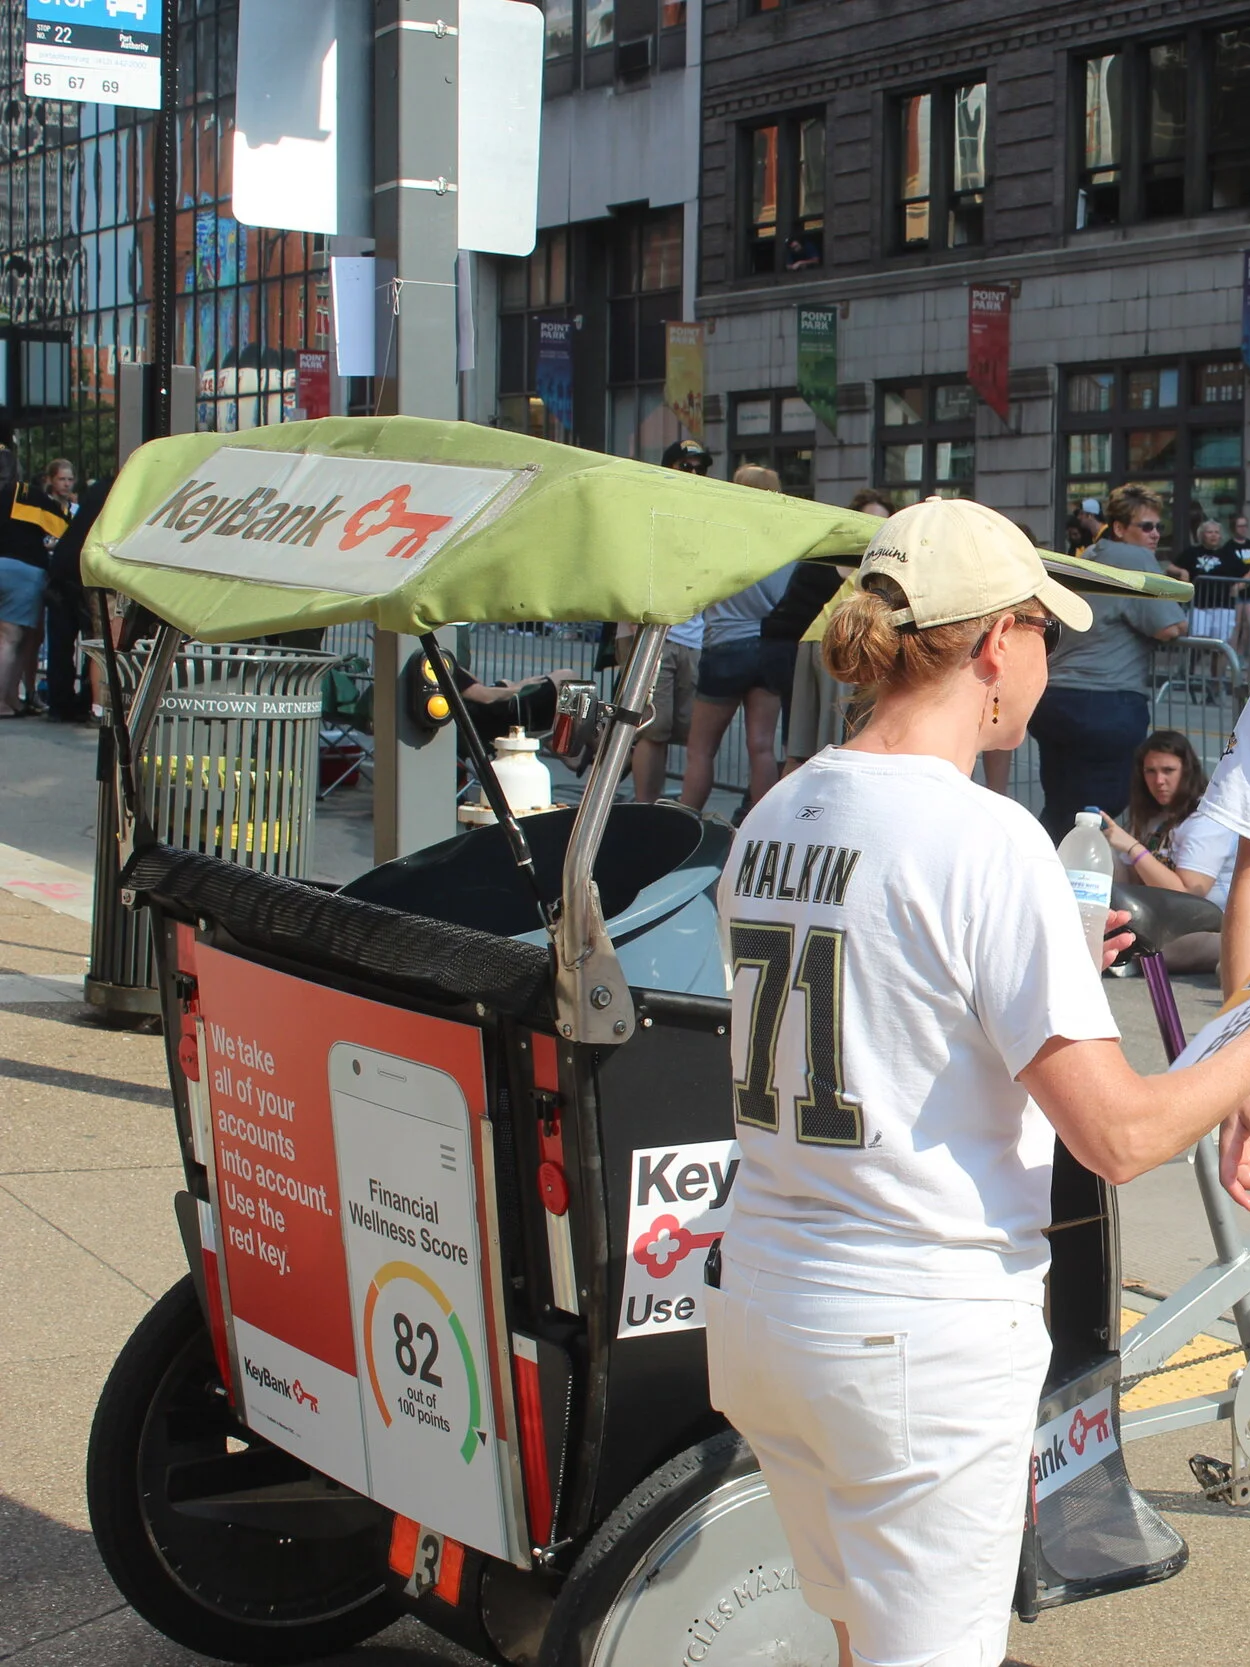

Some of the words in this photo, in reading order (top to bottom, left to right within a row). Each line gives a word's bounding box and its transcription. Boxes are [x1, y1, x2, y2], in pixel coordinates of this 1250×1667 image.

[36, 24, 52, 33] STOP
[54, 25, 72, 44] 22
[119, 33, 132, 43] Port
[120, 42, 149, 53] Authority
[34, 73, 52, 87] 65
[68, 76, 86, 90] 67
[102, 80, 120, 94] 69
[972, 290, 1007, 302] POINT
[972, 300, 1002, 312] PARK
[540, 322, 571, 333] POINT
[801, 311, 834, 322] POINT
[801, 320, 829, 330] PARK
[540, 331, 566, 341] PARK
[300, 353, 327, 362] POINT
[300, 361, 323, 370] PARK
[146, 479, 345, 548] KeyBank
[158, 697, 256, 713] DOWNTOWN
[734, 840, 862, 906] MALKIN
[210, 1022, 236, 1060] We
[237, 1035, 275, 1076] take
[730, 918, 866, 1149] 71
[215, 1066, 233, 1098] all
[236, 1077, 253, 1106] of
[256, 1086, 296, 1122] your
[218, 1109, 296, 1162] accounts
[220, 1140, 252, 1181] into
[256, 1163, 333, 1217] account.
[225, 1180, 255, 1220] Use
[258, 1197, 285, 1233] the
[368, 1178, 439, 1225] Financial
[228, 1222, 254, 1256] red
[257, 1232, 291, 1276] key.
[348, 1200, 416, 1249] Wellness
[420, 1228, 469, 1266] Score
[626, 1294, 696, 1327] Use
[393, 1312, 443, 1389] 82
[243, 1355, 292, 1400] KeyBank
[397, 1397, 415, 1418] 100
[418, 1406, 451, 1433] points
[407, 1386, 424, 1405] out
[426, 1393, 437, 1411] of
[415, 1533, 440, 1593] 3
